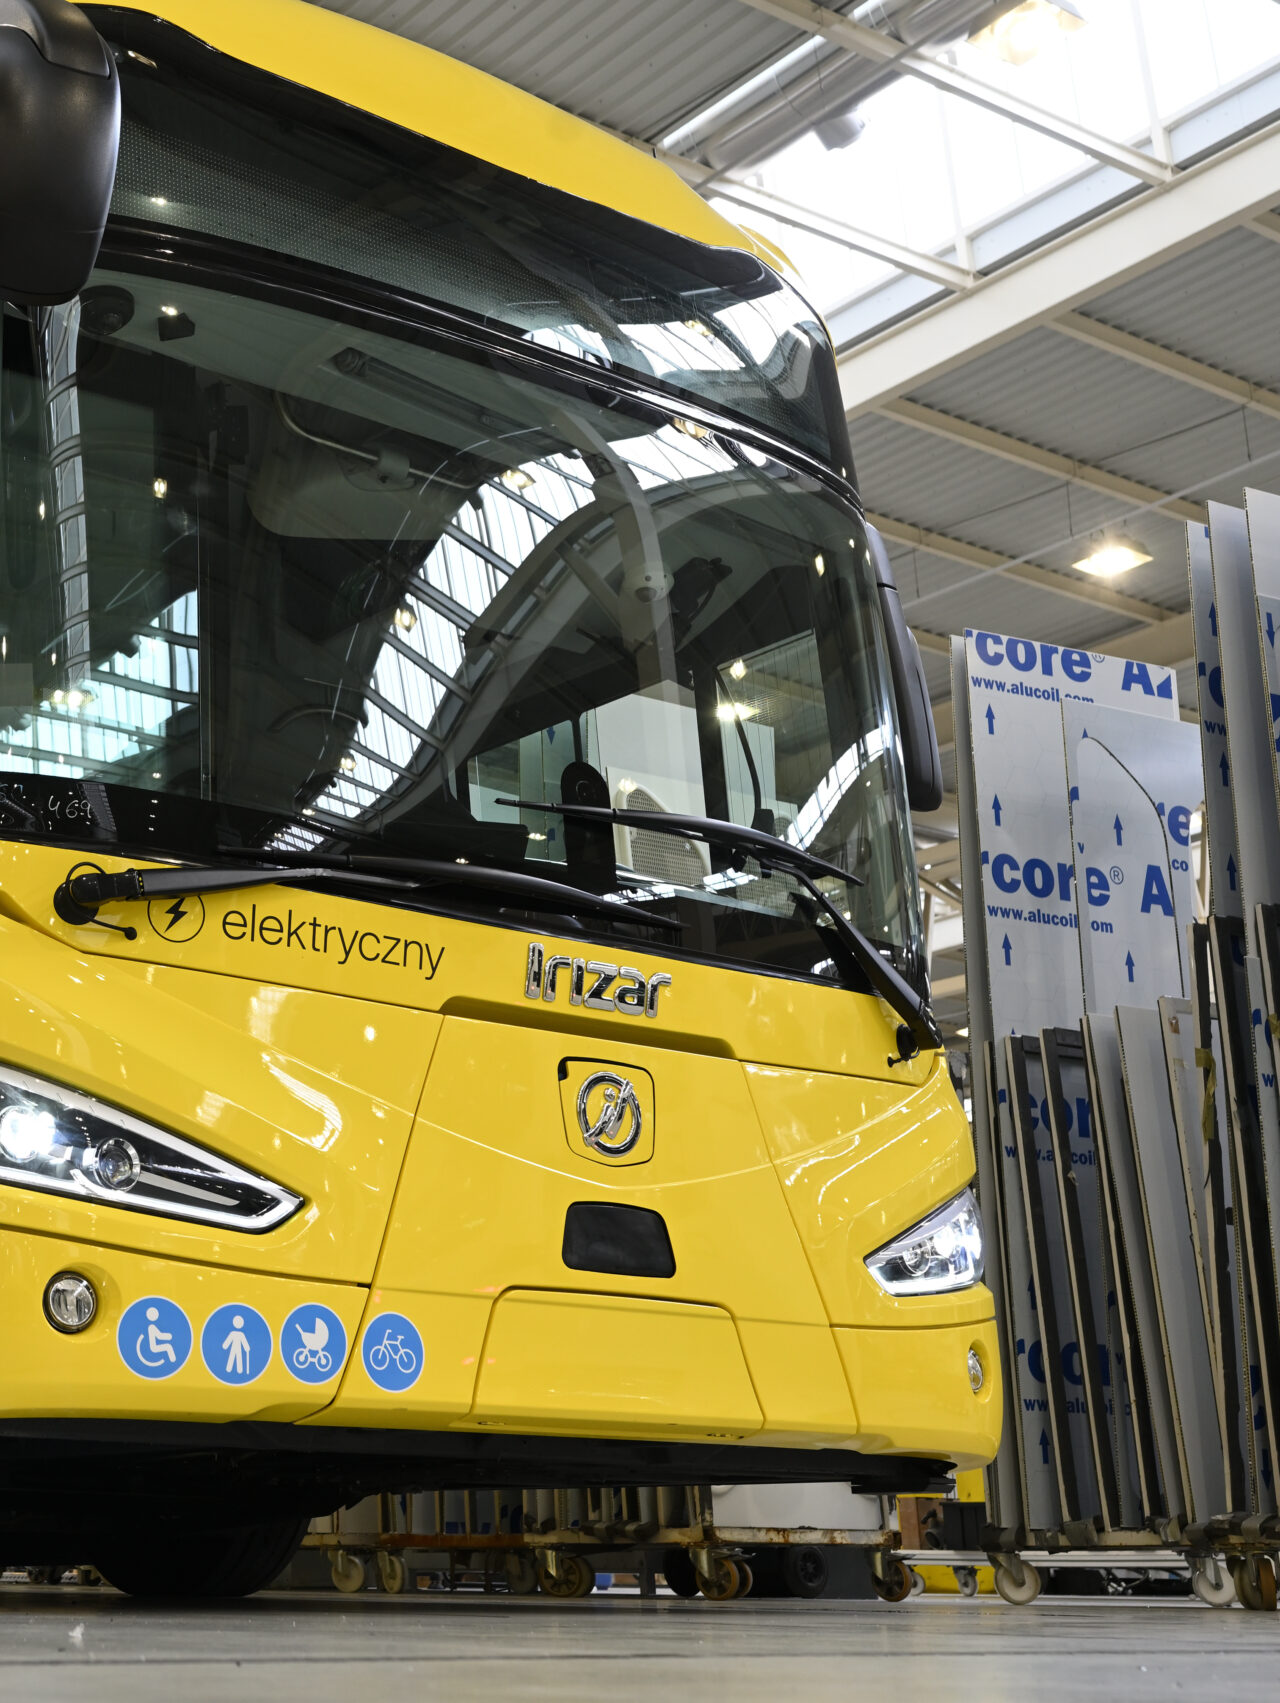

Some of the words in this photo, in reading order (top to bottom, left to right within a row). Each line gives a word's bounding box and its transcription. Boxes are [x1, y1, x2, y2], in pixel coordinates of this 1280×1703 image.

[48, 795, 92, 819] 469
[222, 904, 446, 981] elektryczny
[524, 942, 673, 1018] Irizar
